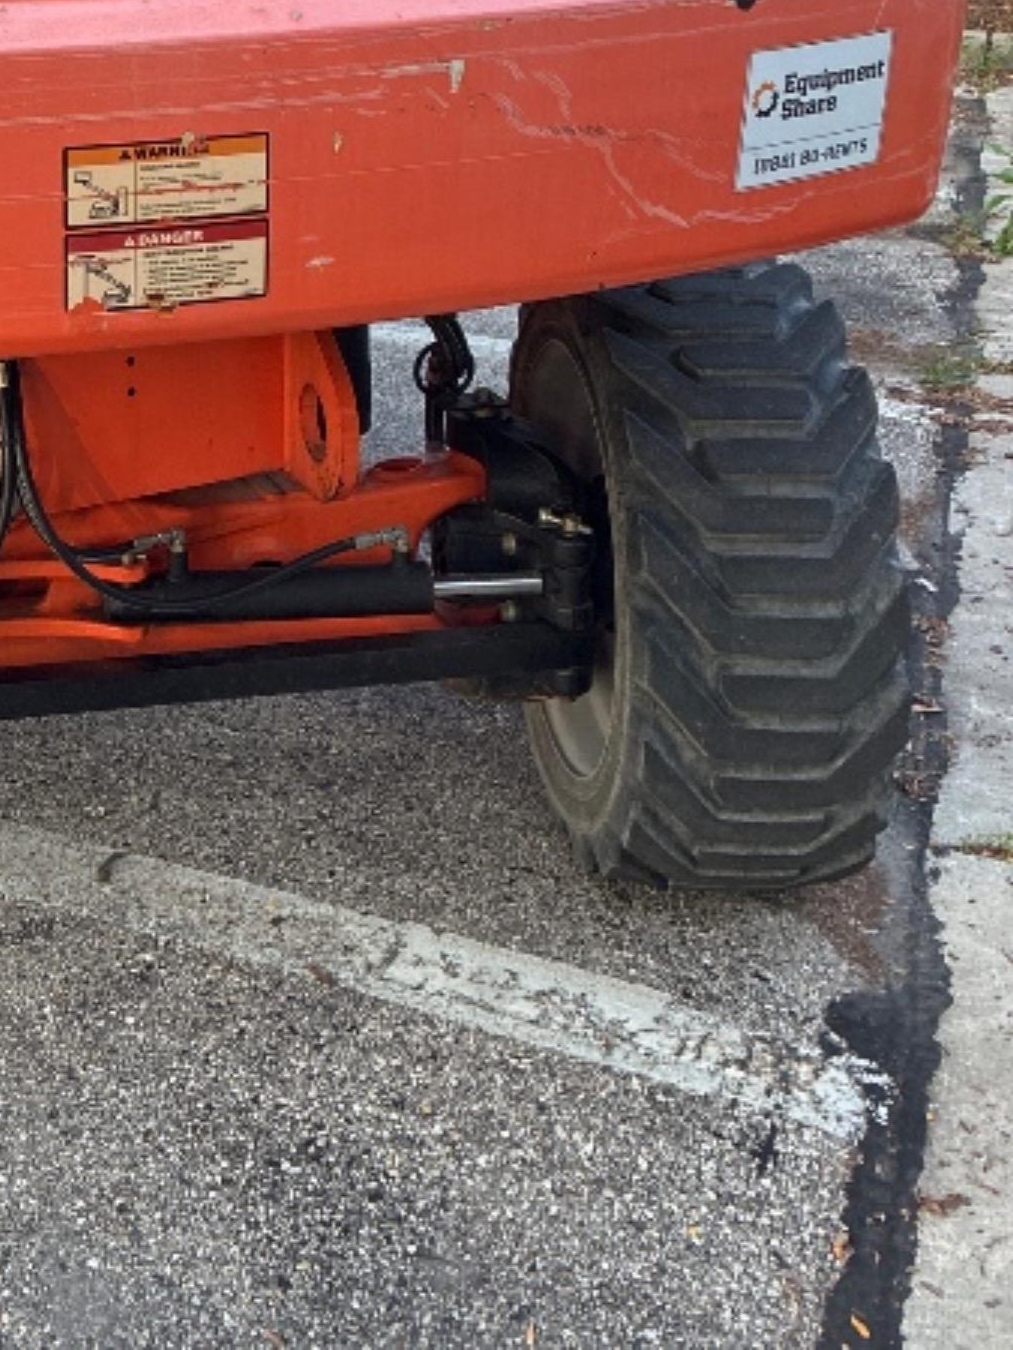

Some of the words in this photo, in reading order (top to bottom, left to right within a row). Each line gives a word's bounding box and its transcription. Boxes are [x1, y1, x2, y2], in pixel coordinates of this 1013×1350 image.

[784, 59, 885, 96] Equipment
[781, 96, 838, 120] Share
[133, 144, 210, 161] WARNI
